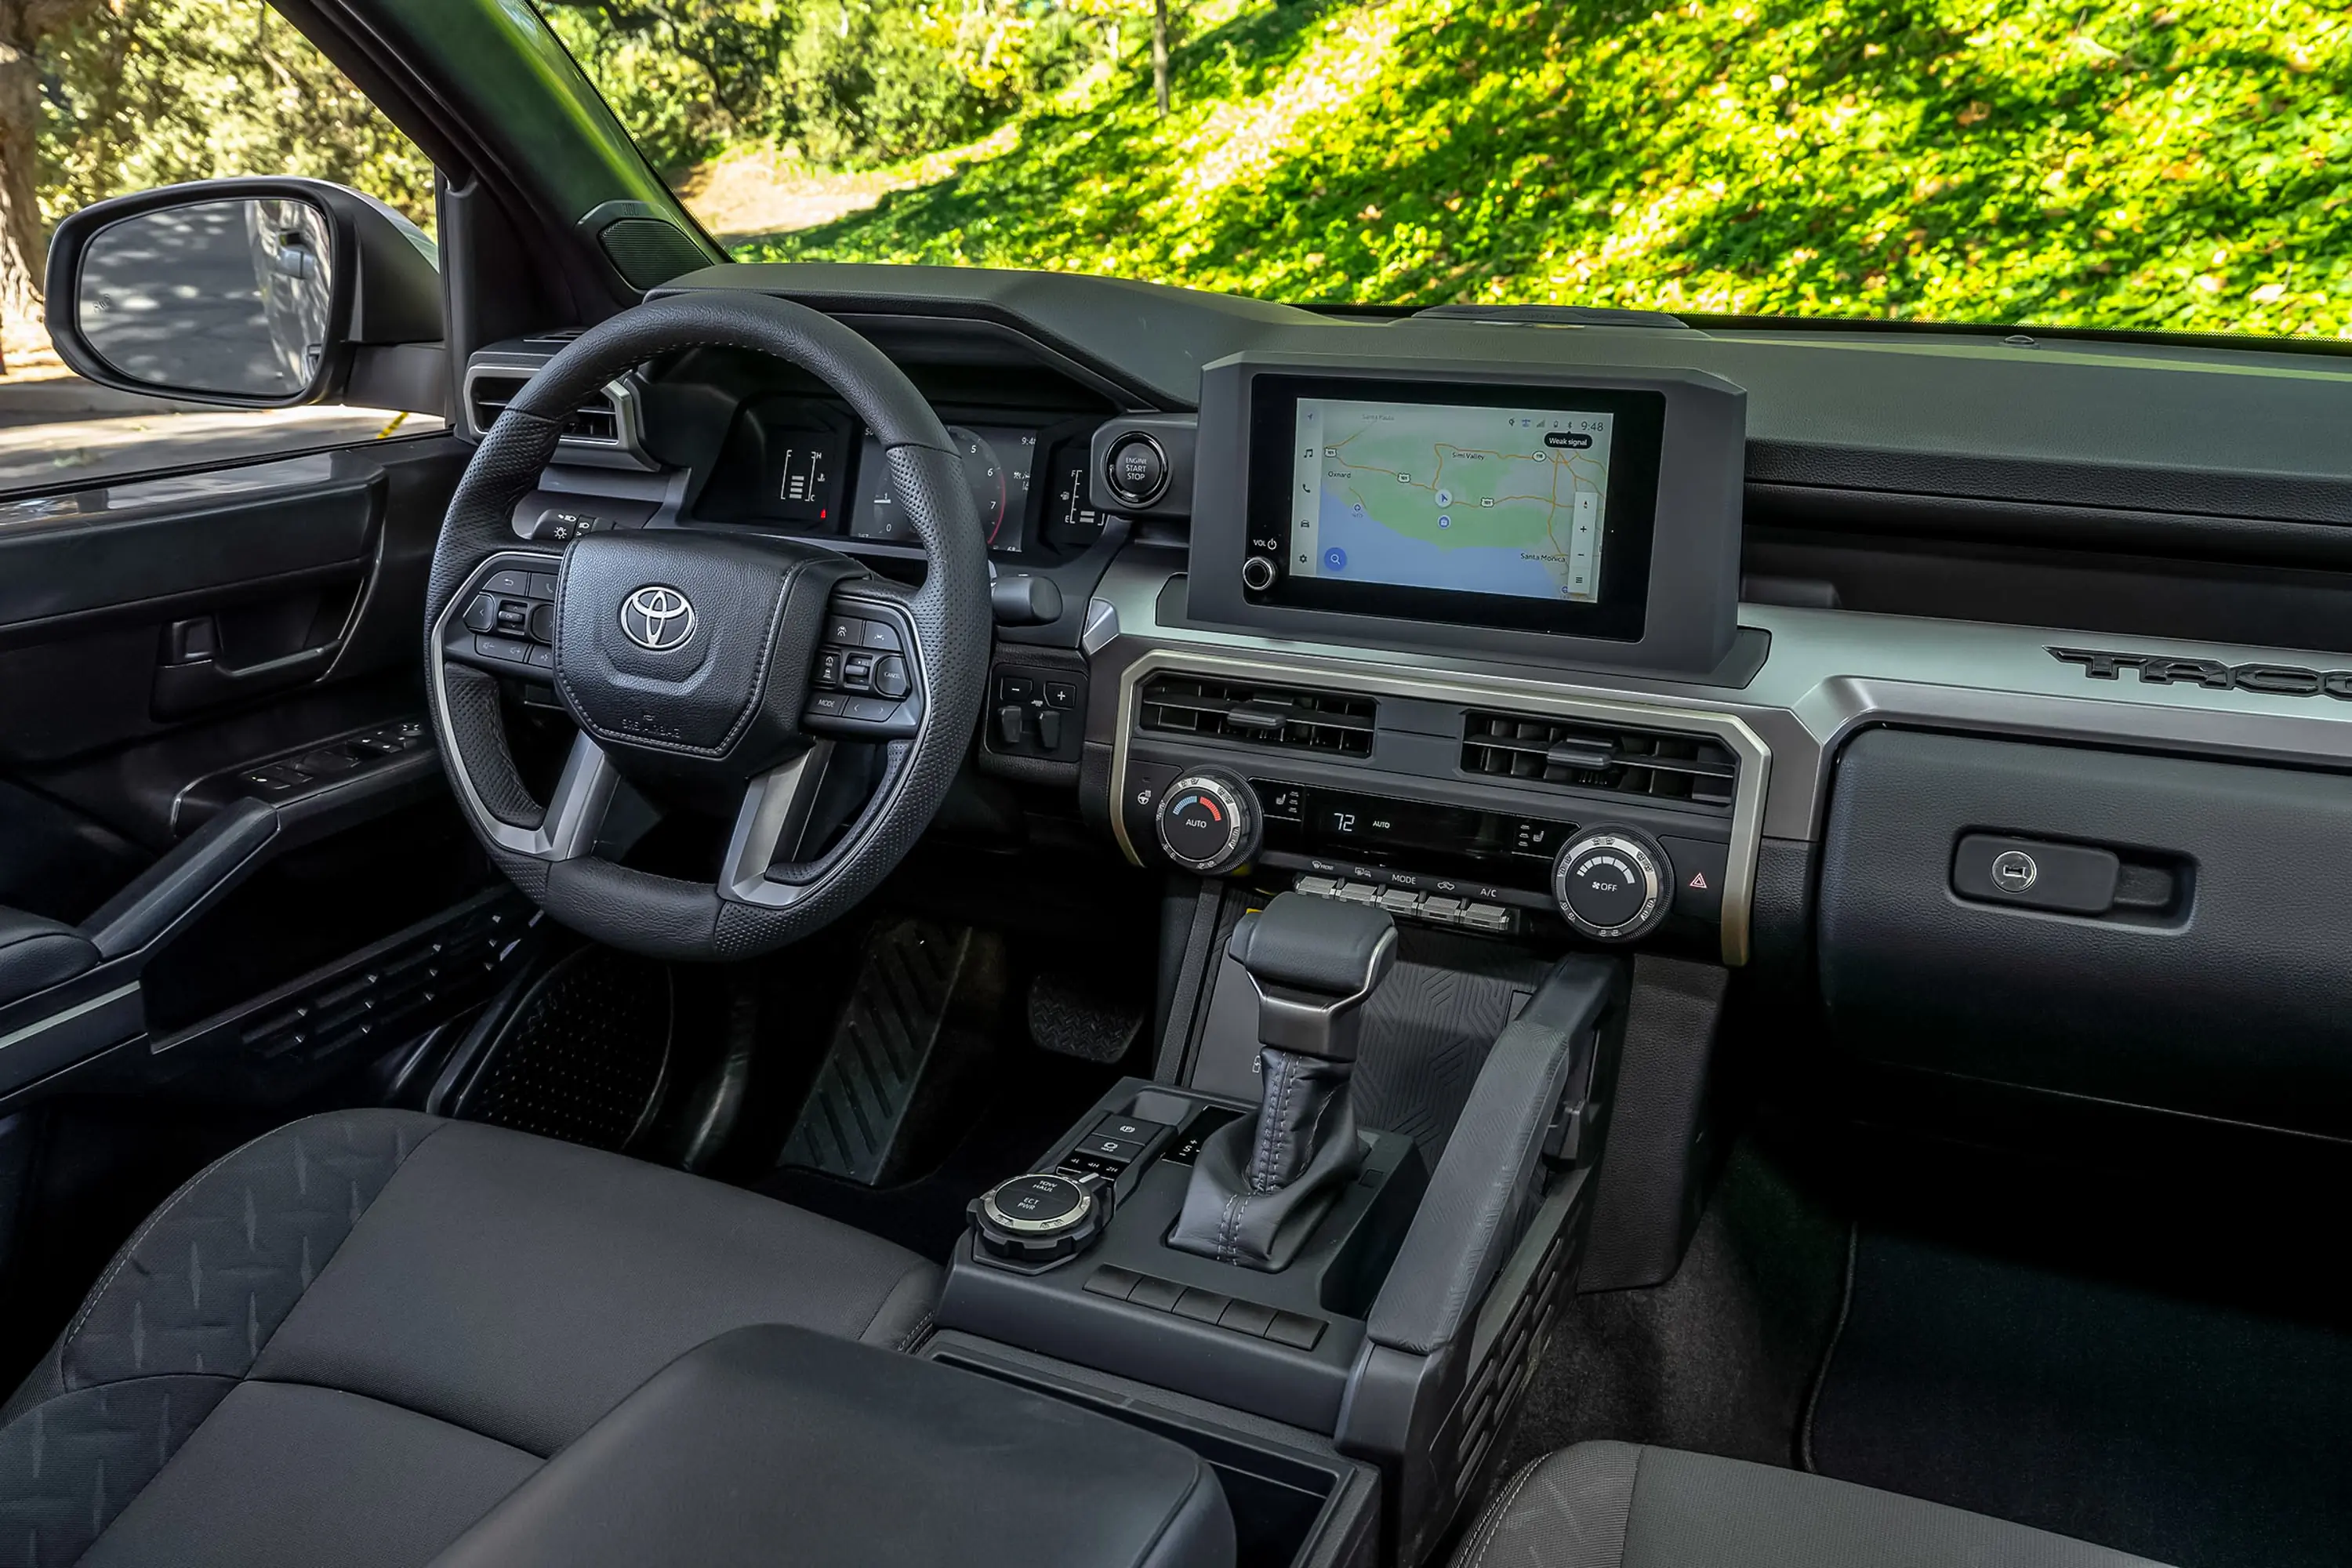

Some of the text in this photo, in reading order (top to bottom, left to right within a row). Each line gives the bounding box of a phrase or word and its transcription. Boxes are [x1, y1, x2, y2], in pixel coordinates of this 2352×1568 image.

[1581, 420, 1604, 432] 9:48
[1022, 437, 1036, 445] 9:4
[1568, 438, 1587, 447] signal
[971, 445, 977, 454] 5
[987, 468, 993, 477] 6
[1127, 472, 1145, 481] STOP
[1327, 470, 1352, 479] Oxnard
[990, 501, 996, 510] 7
[886, 523, 892, 532] 0
[1253, 539, 1267, 547] VOL
[1520, 552, 1566, 563] Santa Monica
[818, 699, 836, 708] MODE
[1185, 818, 1207, 829] AUTO
[1334, 812, 1356, 832] 72
[1372, 820, 1391, 829] AUTO
[1392, 873, 1417, 885] MODE
[1600, 883, 1618, 892] OFF
[1479, 887, 1497, 898] A/C
[1032, 1184, 1054, 1192] HAUL
[1023, 1196, 1040, 1205] ECT
[1017, 1202, 1036, 1210] PWR
